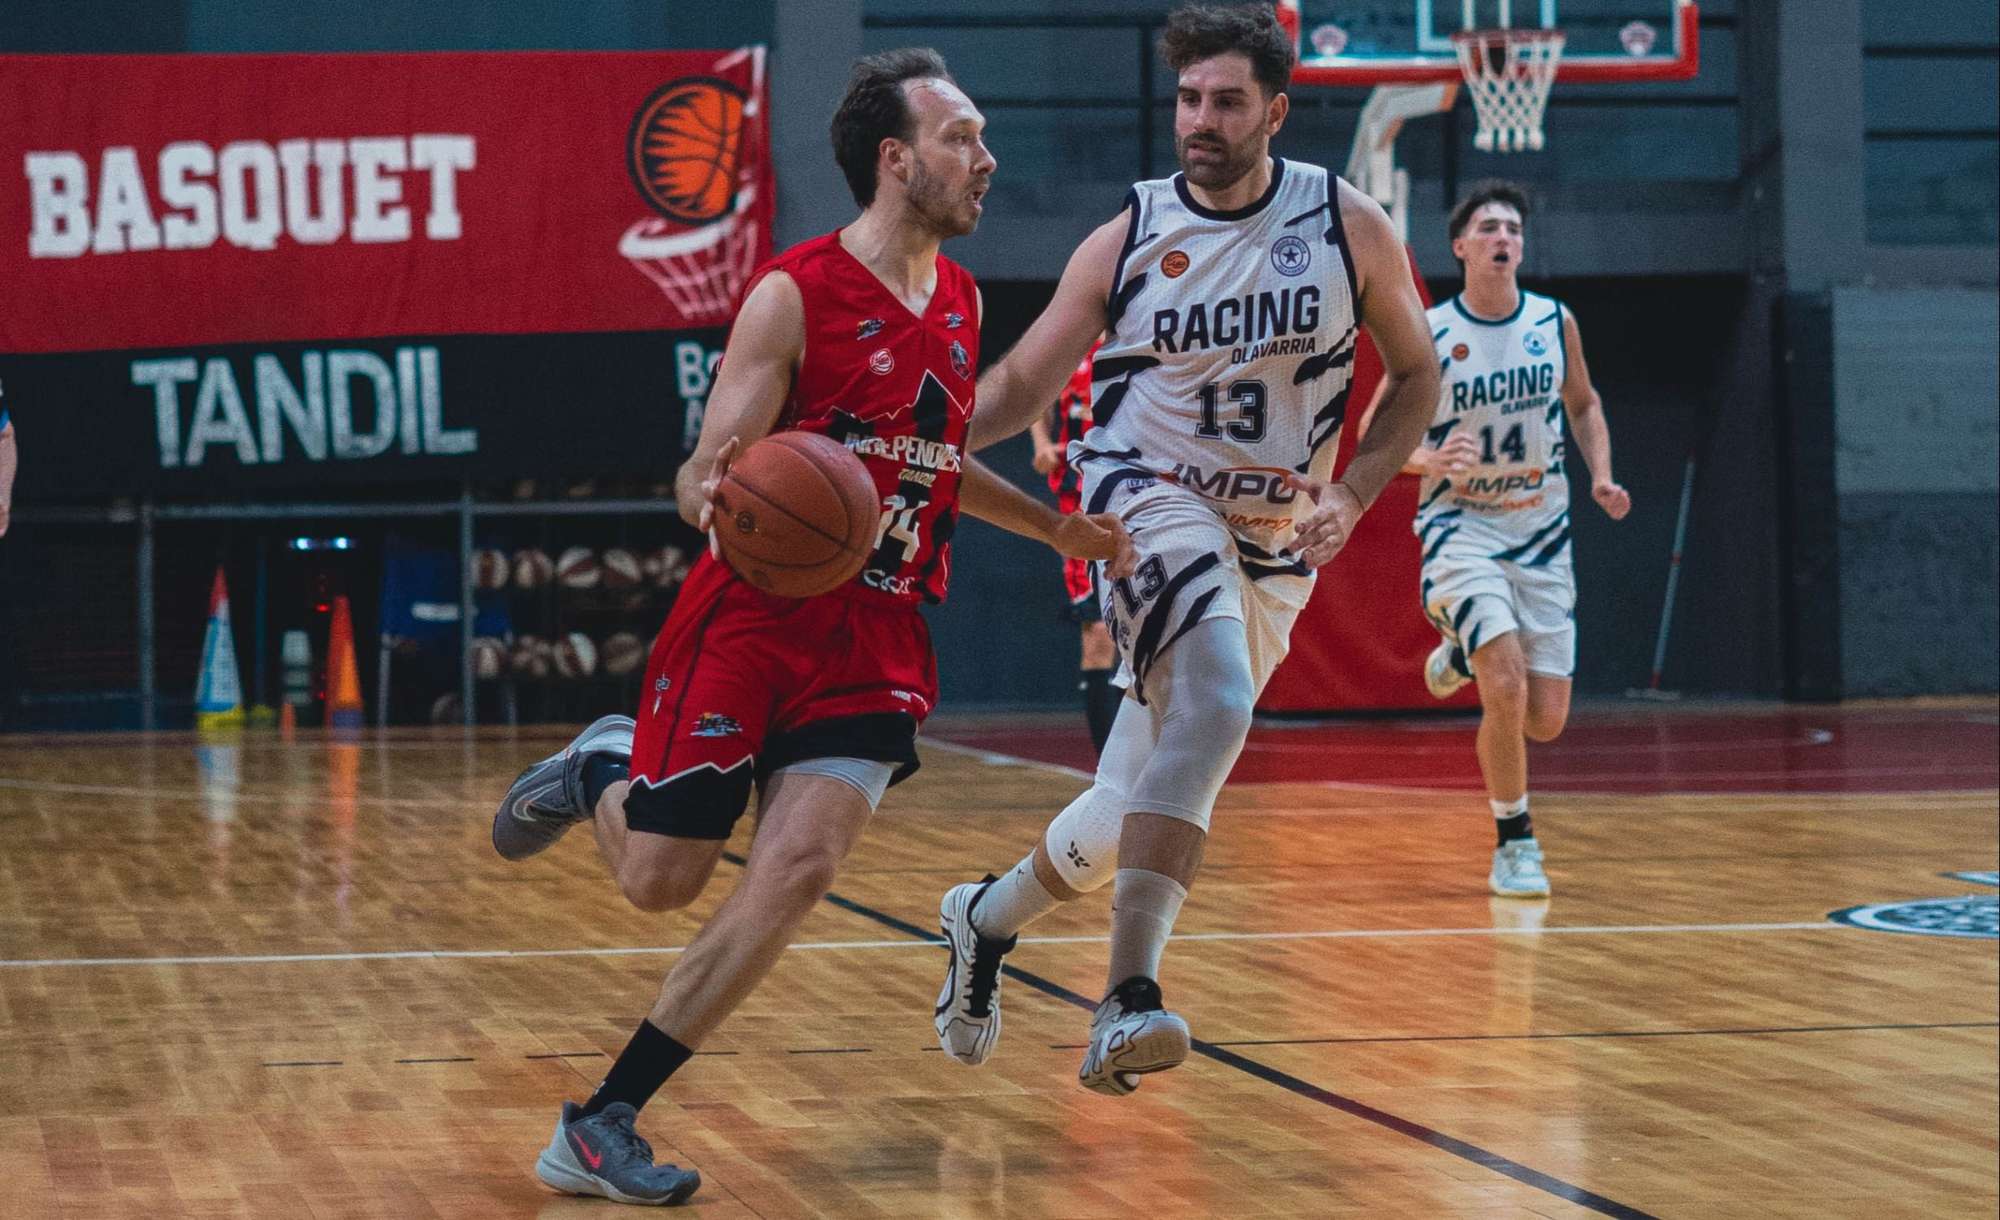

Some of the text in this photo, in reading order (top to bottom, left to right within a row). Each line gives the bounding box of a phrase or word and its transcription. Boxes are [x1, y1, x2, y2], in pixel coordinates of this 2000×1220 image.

[25, 134, 477, 258] BASQUET
[1152, 284, 1320, 354] RACING
[1231, 336, 1316, 365] OLAVARRIA
[676, 341, 724, 399] B
[1452, 362, 1554, 413] RACING
[130, 347, 478, 467] TANDIL
[1195, 379, 1268, 444] 13
[1478, 421, 1527, 464] 14
[1112, 553, 1169, 619] 13
